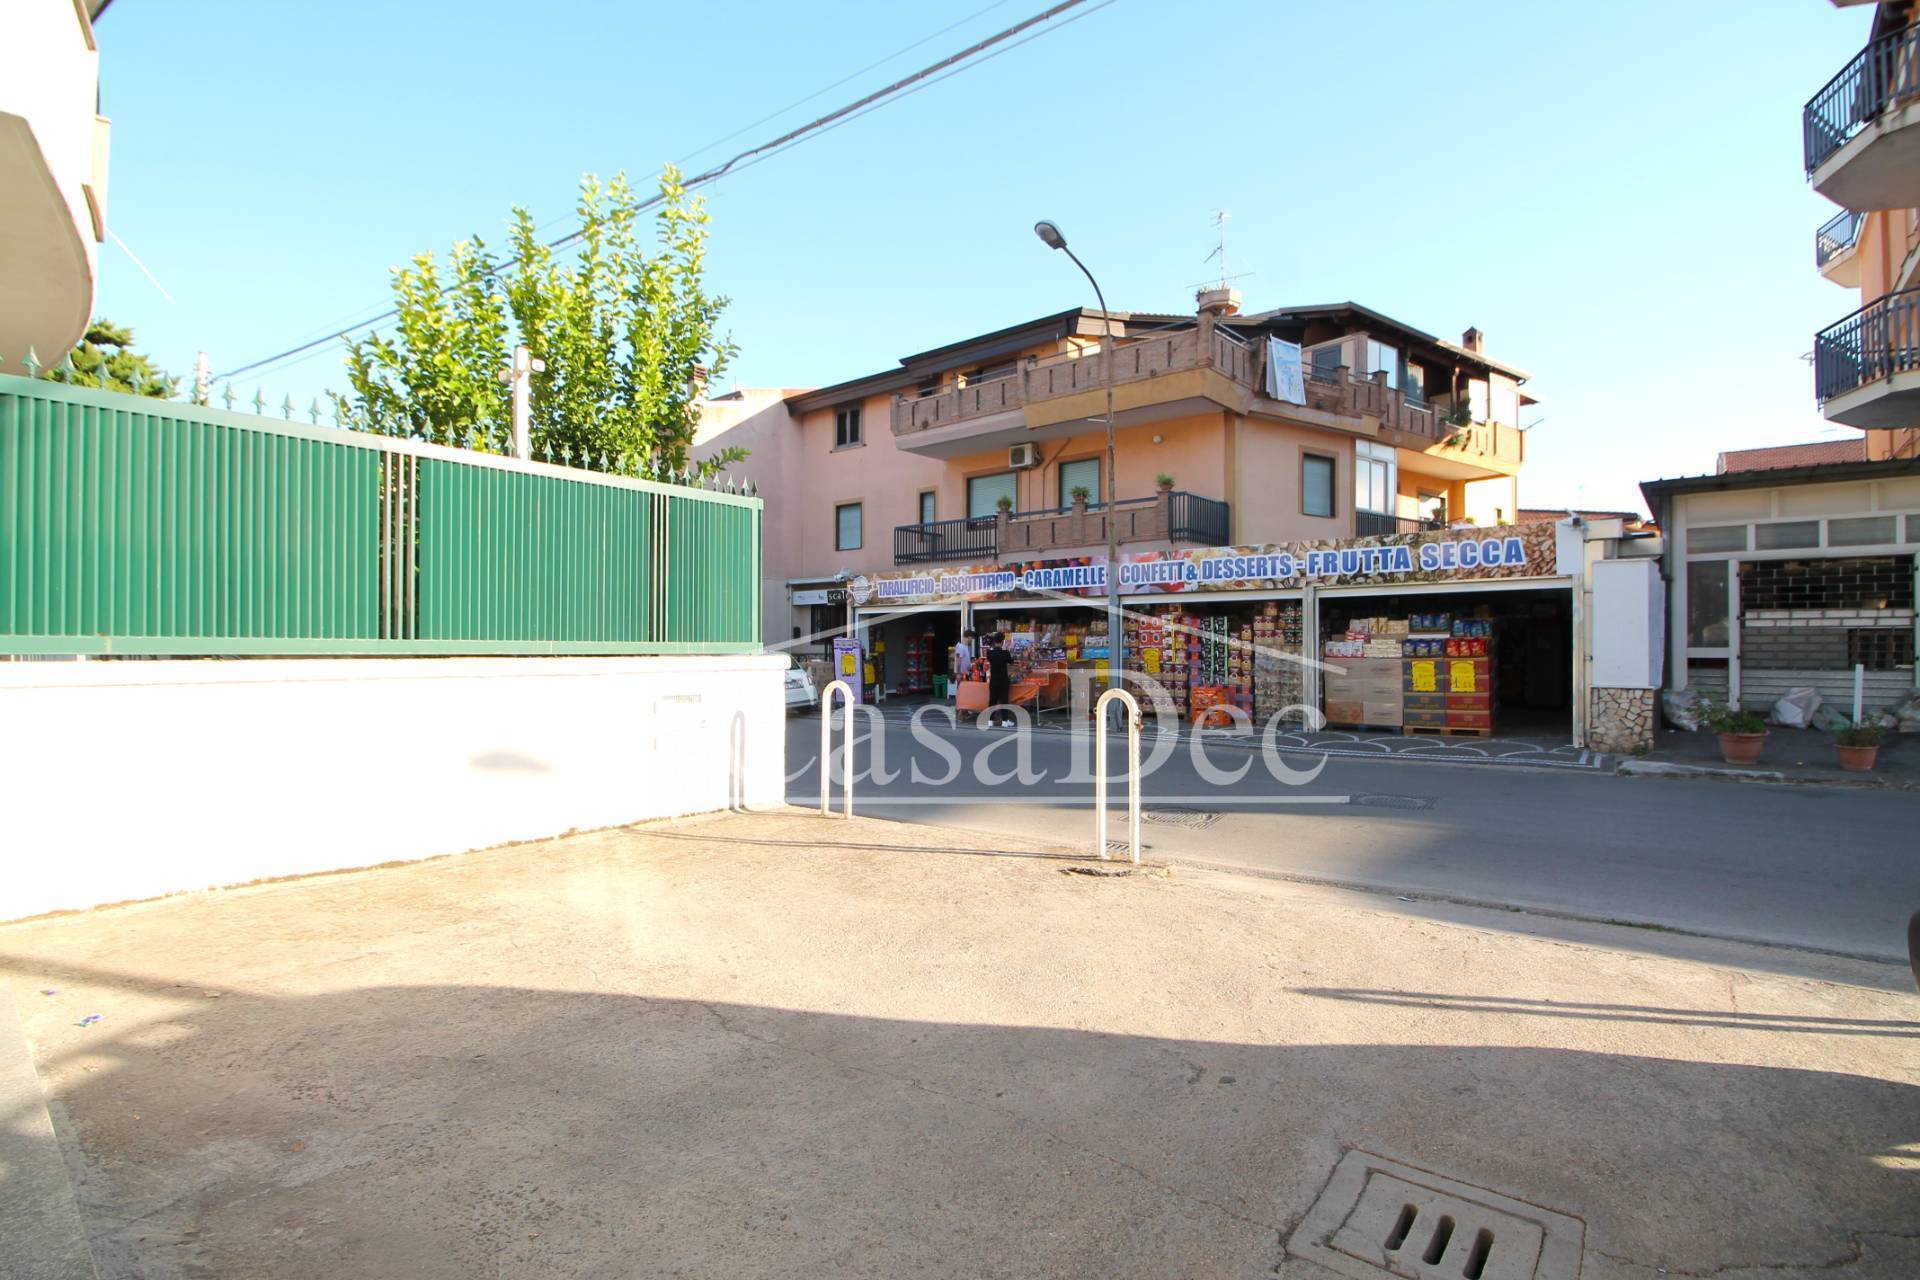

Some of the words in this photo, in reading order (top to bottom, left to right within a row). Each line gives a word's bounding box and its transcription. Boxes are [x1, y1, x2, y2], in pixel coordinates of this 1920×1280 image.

[878, 577, 936, 597] TARALLIFICIO
[941, 572, 1014, 594] BISCOTTIFICIO
[1024, 566, 1106, 588] CARAMELLE
[1185, 563, 1198, 581] &
[1202, 554, 1292, 580] DESSERTS
[1308, 546, 1411, 574] FRUTTA
[1422, 538, 1525, 570] SECCA
